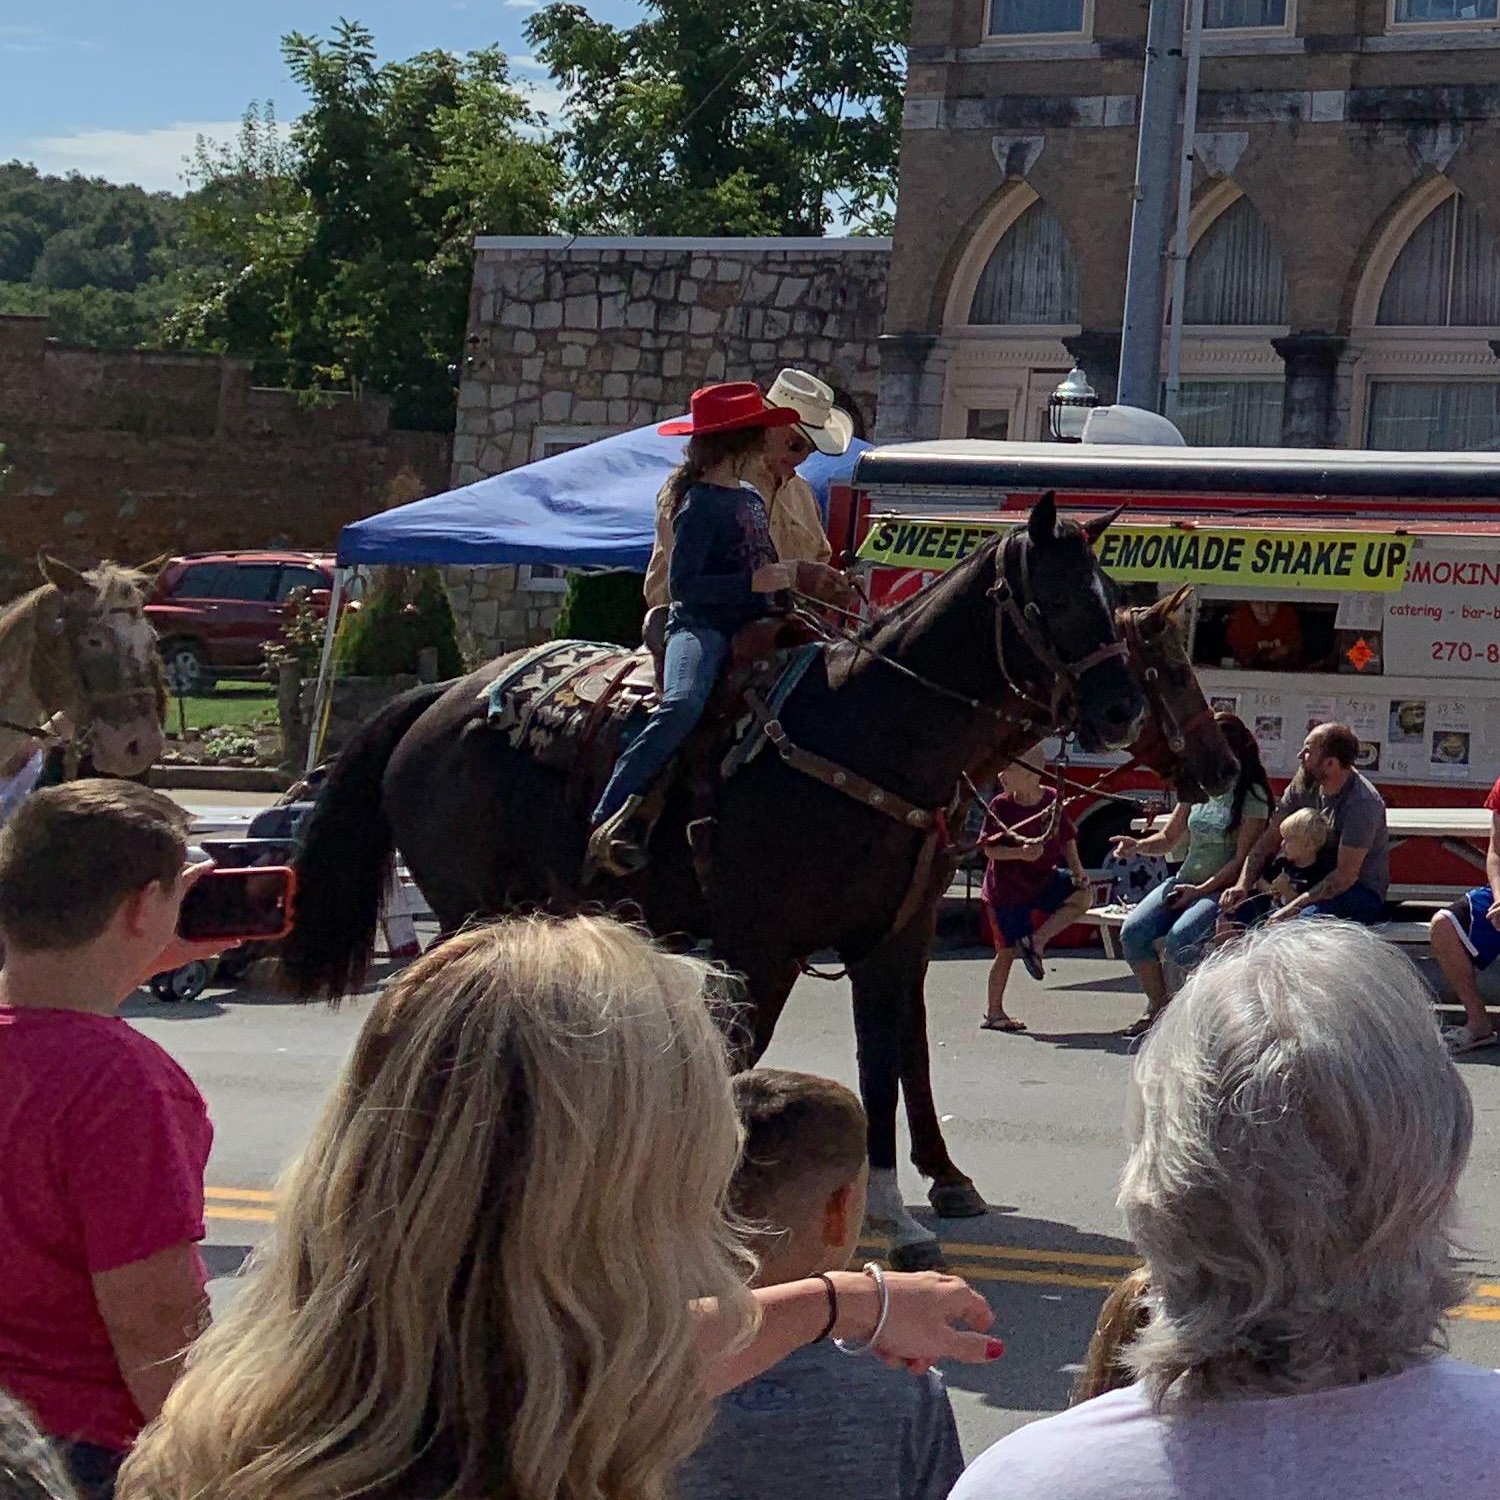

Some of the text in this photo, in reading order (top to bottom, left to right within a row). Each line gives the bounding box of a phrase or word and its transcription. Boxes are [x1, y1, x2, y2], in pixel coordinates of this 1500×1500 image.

[1100, 534, 1245, 572] EMONADE
[1251, 538, 1356, 576] SHAKE
[1363, 542, 1407, 578] UP
[1390, 603, 1442, 621] catering
